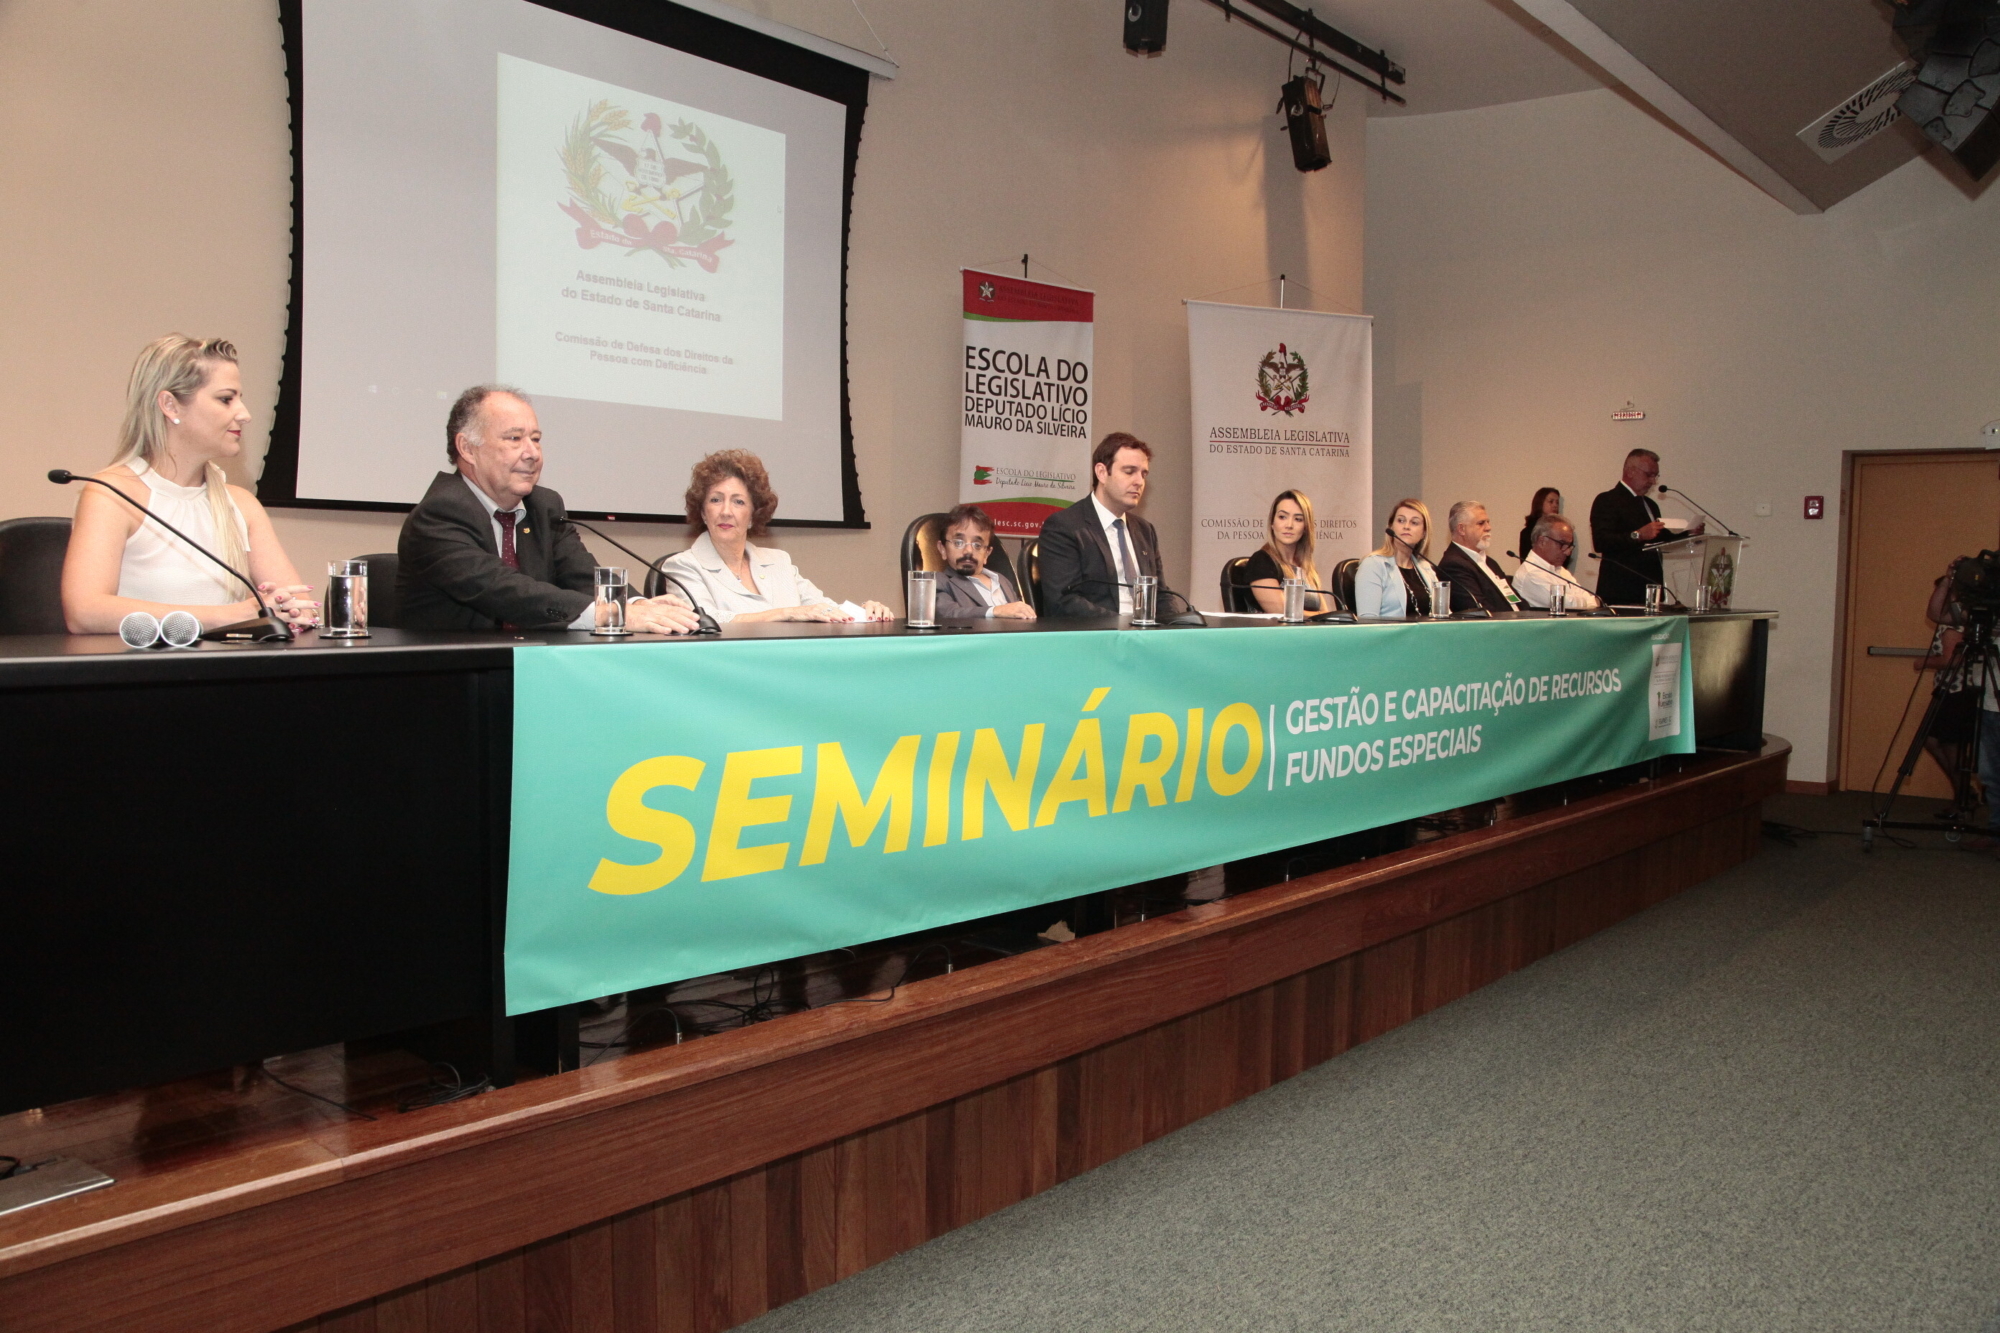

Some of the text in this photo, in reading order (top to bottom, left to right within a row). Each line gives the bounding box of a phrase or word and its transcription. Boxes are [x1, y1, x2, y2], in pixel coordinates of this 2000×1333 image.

[576, 269, 706, 302] Assembleia Legislativa
[561, 286, 721, 322] do Estado de Santa Catarina
[555, 331, 734, 365] Comissão de Defesa dos Direitos da
[590, 350, 707, 374] Pessoa com Deficiência
[966, 346, 1088, 384] ESCOLA DO
[965, 372, 1088, 407] LEGISLATIVO
[964, 396, 1088, 424] DEPUTADO LÍCIO
[964, 413, 1086, 439] MAURO DA SILVEIRA
[1210, 426, 1350, 444] ASSEMBLEIA LEGISLATIVA
[1210, 444, 1350, 458] DO ESTADO DE SANTA CATARINA
[996, 468, 1022, 477] ESCOLA
[1036, 471, 1076, 480] LEGISLATIVO
[994, 518, 1044, 529] lesc.sc.gov.
[1201, 518, 1250, 528] COMISSÃO
[1252, 519, 1264, 528] DE
[1320, 520, 1357, 528] DIREITOS
[1218, 530, 1344, 540] DA PESSOA IÊNCIA
[1286, 668, 1622, 735] GESTÃO E CAPACITAÇÃO DE RECURSOS
[1286, 724, 1482, 787] FUNDOS ESPECIAIS
[588, 686, 1264, 896] SEMINÁRIO
